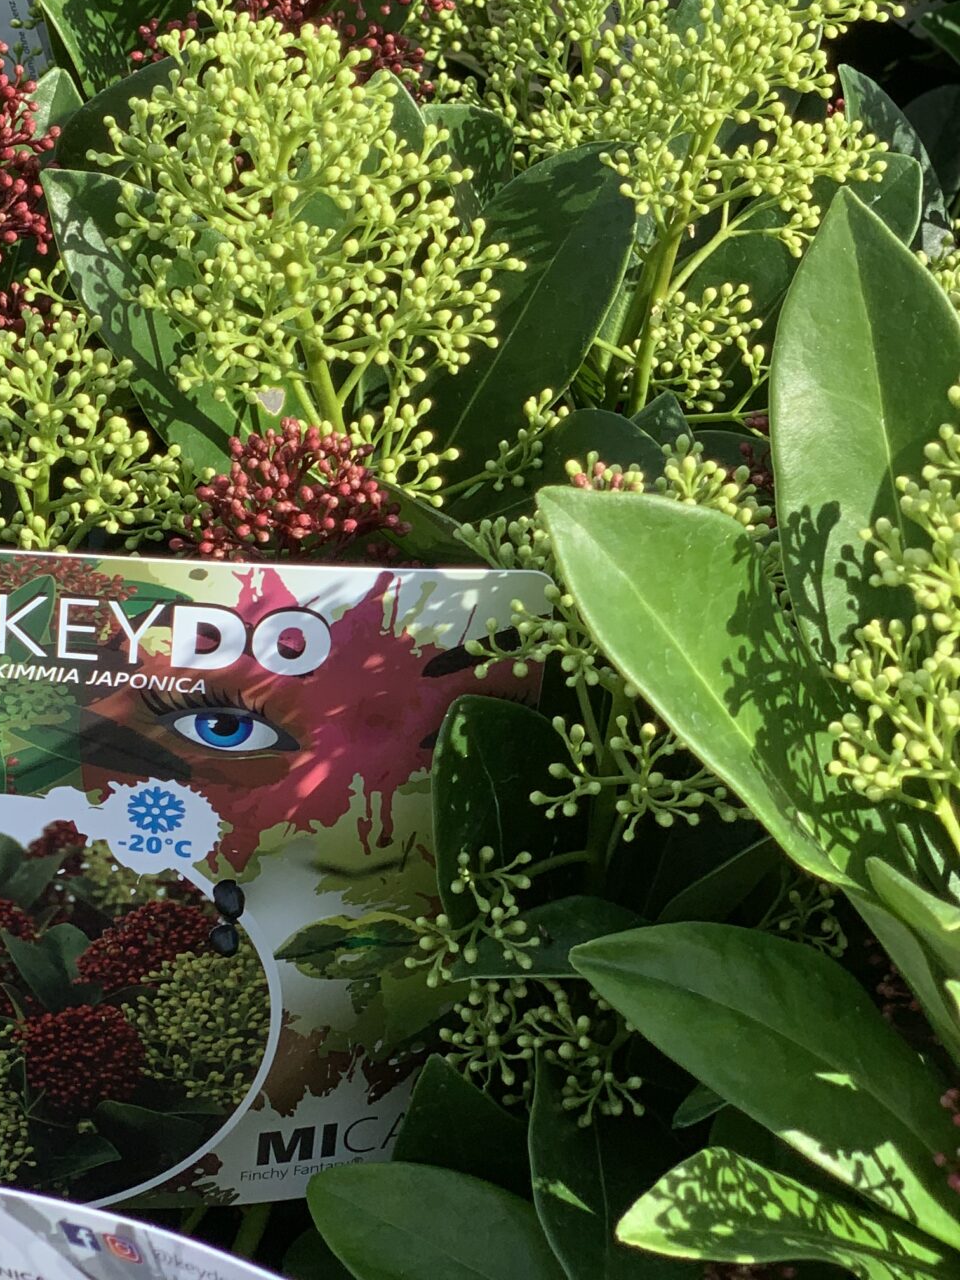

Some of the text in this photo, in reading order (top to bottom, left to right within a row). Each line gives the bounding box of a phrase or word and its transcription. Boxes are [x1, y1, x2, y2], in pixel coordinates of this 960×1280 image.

[86, 670, 207, 695] JAPONICA
[118, 834, 192, 858] -20°C
[240, 1166, 289, 1181] Finchy
